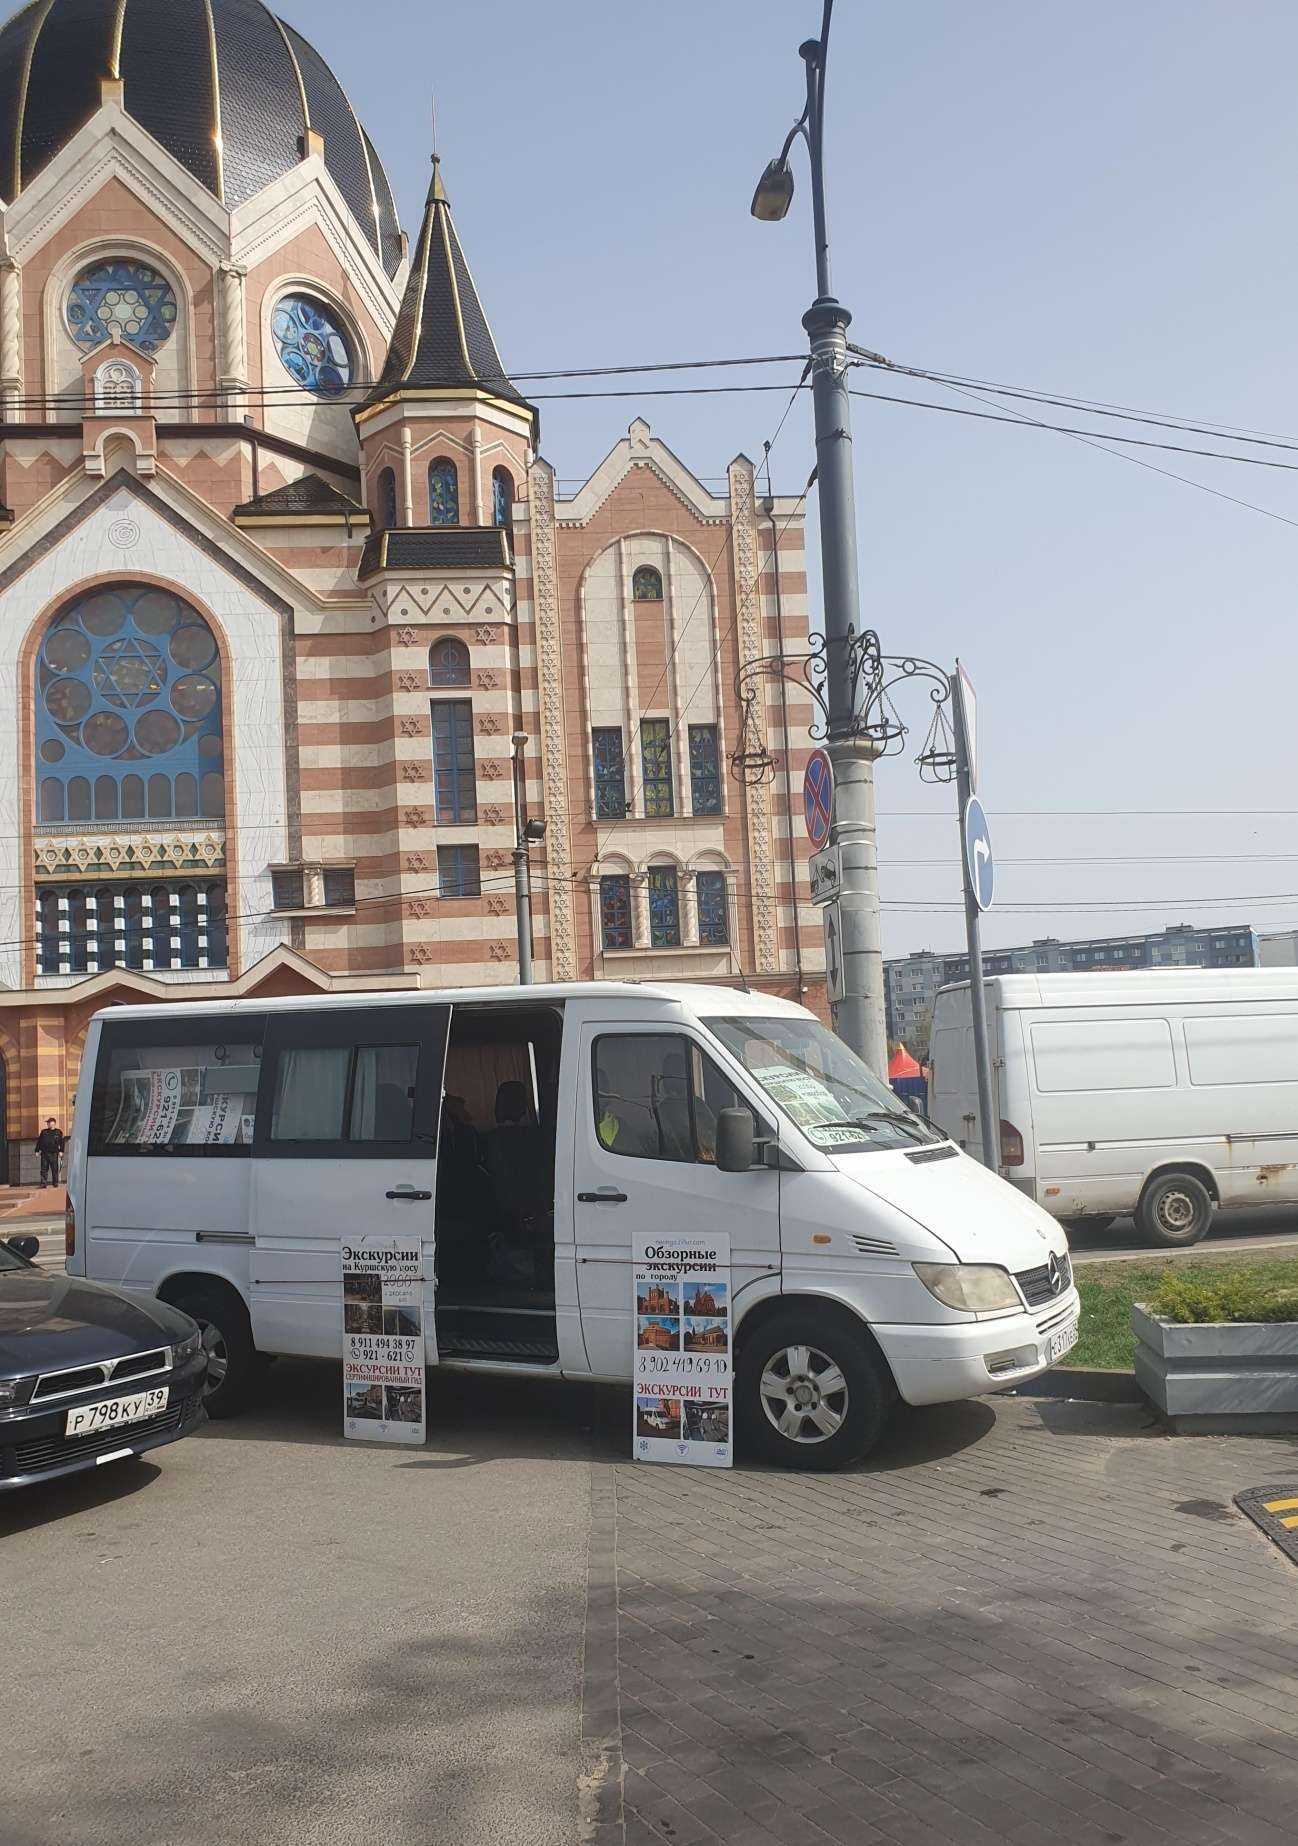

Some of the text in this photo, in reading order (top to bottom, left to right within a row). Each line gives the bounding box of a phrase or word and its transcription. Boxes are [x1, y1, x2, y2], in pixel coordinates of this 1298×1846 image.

[342, 1246, 418, 1264] Экскурсии
[645, 1245, 717, 1262] Обзорные
[354, 1262, 397, 1273] Куршскую
[645, 1262, 717, 1274] экскурсии
[650, 1273, 678, 1281] городу
[351, 1336, 416, 1350] 8 911 494 38 97
[363, 1349, 379, 1361] 921
[387, 1350, 403, 1362] 621
[345, 1363, 422, 1377] ЭКСУРСИИ ТУТ
[639, 1356, 647, 1373] 8
[649, 1355, 670, 1373] 902
[637, 1382, 729, 1399] ЭКСКУРСИИ ТУТ
[147, 1390, 164, 1407] 39
